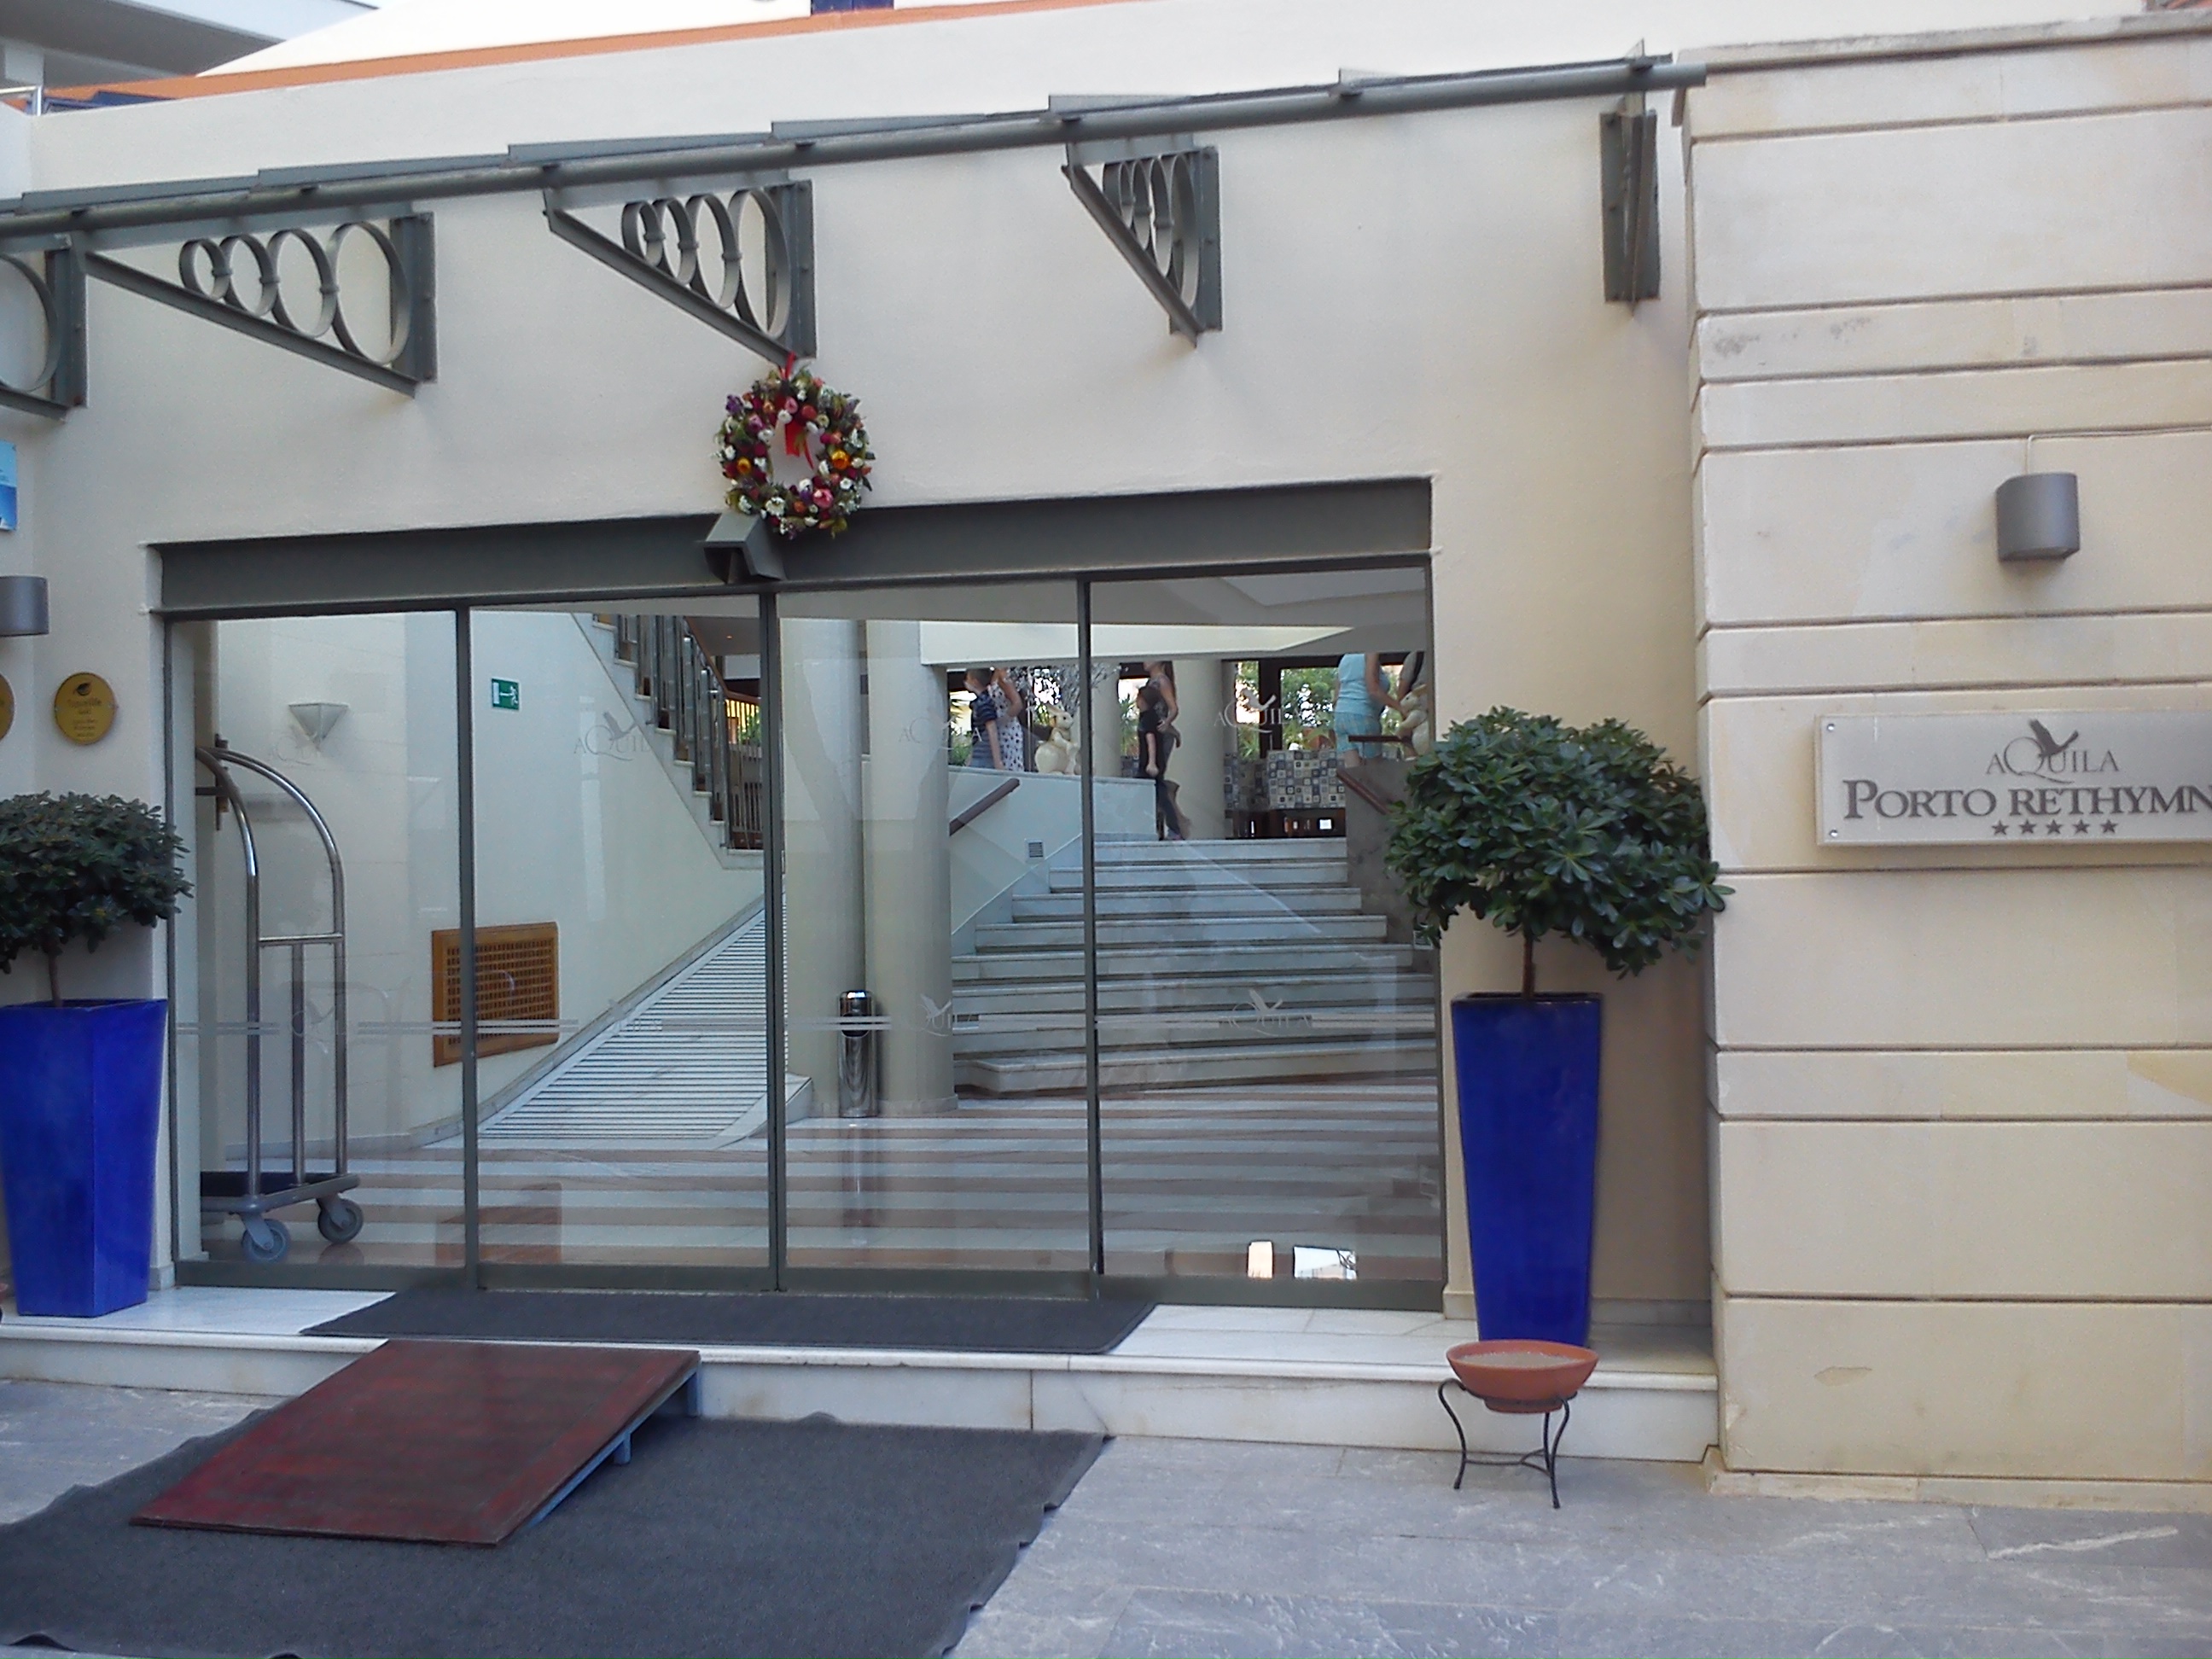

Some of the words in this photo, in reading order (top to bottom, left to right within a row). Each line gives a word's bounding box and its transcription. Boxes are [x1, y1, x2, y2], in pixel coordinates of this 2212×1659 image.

[573, 725, 656, 761] AQUIL
[1986, 736, 2119, 786] AQUILA
[1842, 779, 1997, 819] PORTO
